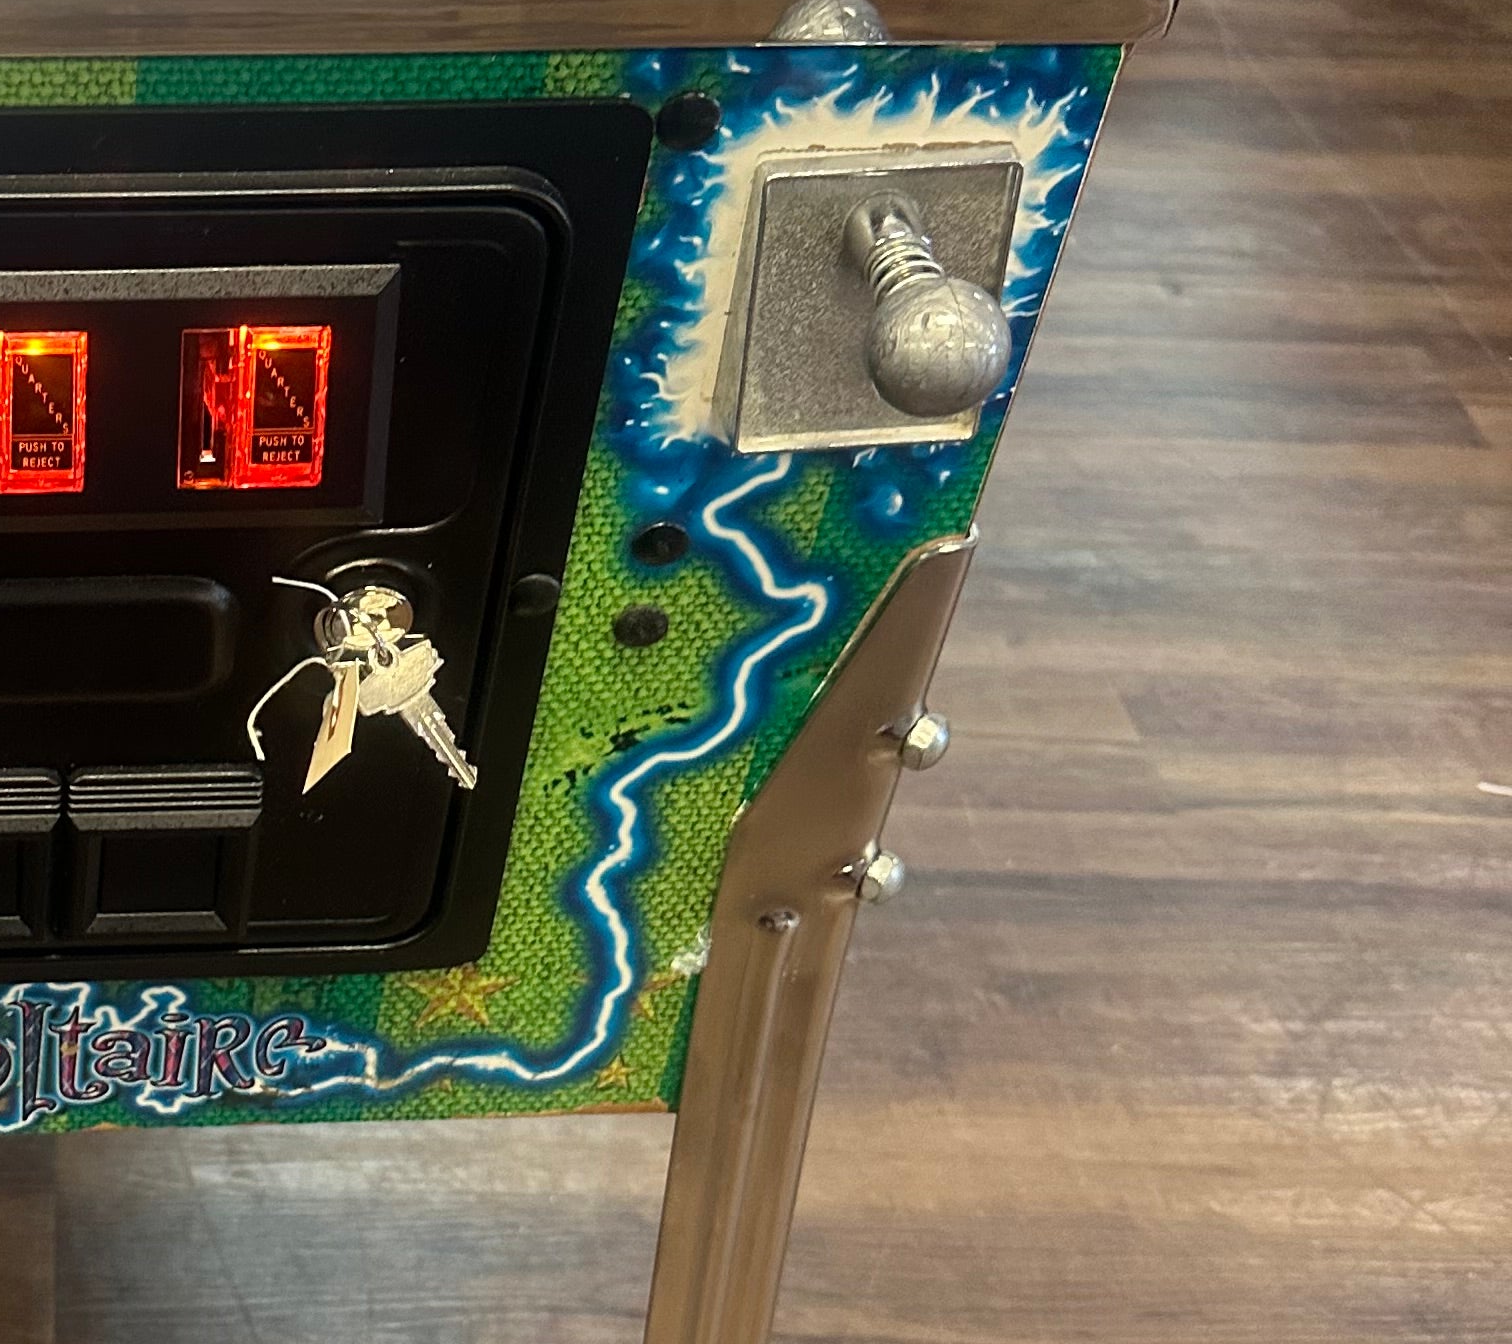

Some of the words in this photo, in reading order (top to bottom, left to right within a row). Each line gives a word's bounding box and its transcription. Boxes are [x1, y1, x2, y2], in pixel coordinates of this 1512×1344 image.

[14, 356, 69, 434] QUARTERS
[258, 351, 310, 428] QUARTERS
[18, 441, 47, 453] PUSH
[52, 441, 65, 452] TO
[259, 435, 287, 447] PUSH
[292, 435, 305, 446] TO
[262, 450, 301, 462] REJECT
[22, 457, 61, 468] REJECT
